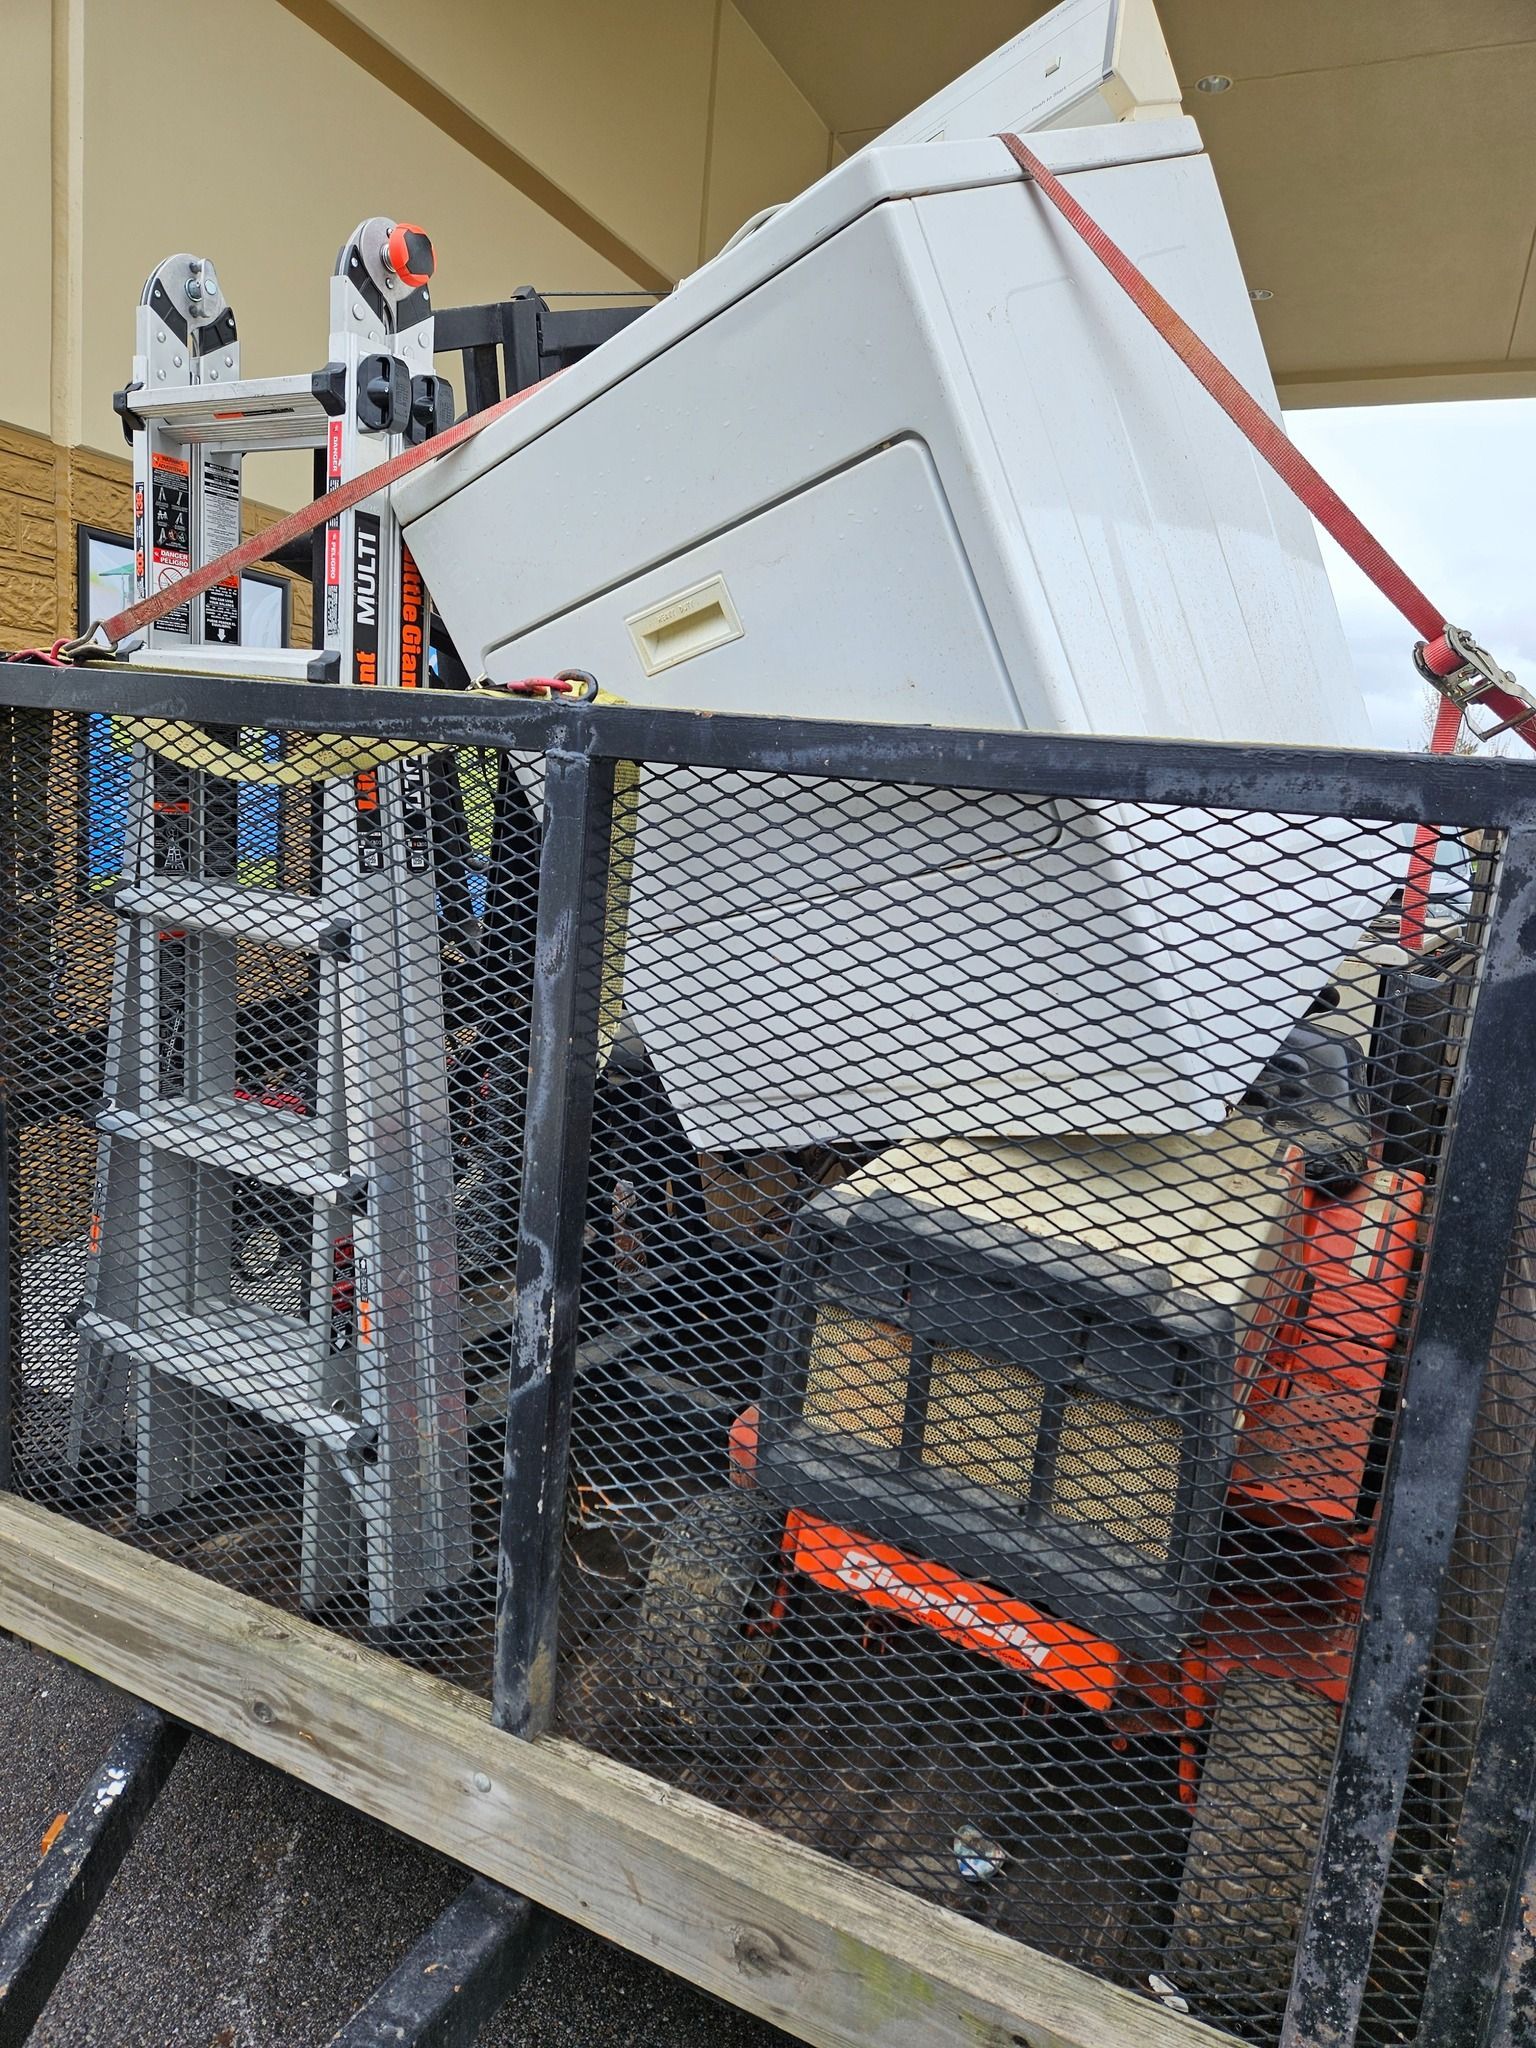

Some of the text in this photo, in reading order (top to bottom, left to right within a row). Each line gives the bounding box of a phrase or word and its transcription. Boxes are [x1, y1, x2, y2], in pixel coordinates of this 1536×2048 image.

[160, 549, 189, 561] DANGER
[160, 556, 189, 568] PELIGRO
[357, 531, 377, 626] MULTI
[402, 542, 422, 688] ittle Gian
[402, 755, 422, 810] ULTI
[835, 1550, 1050, 1667] Simplicity
